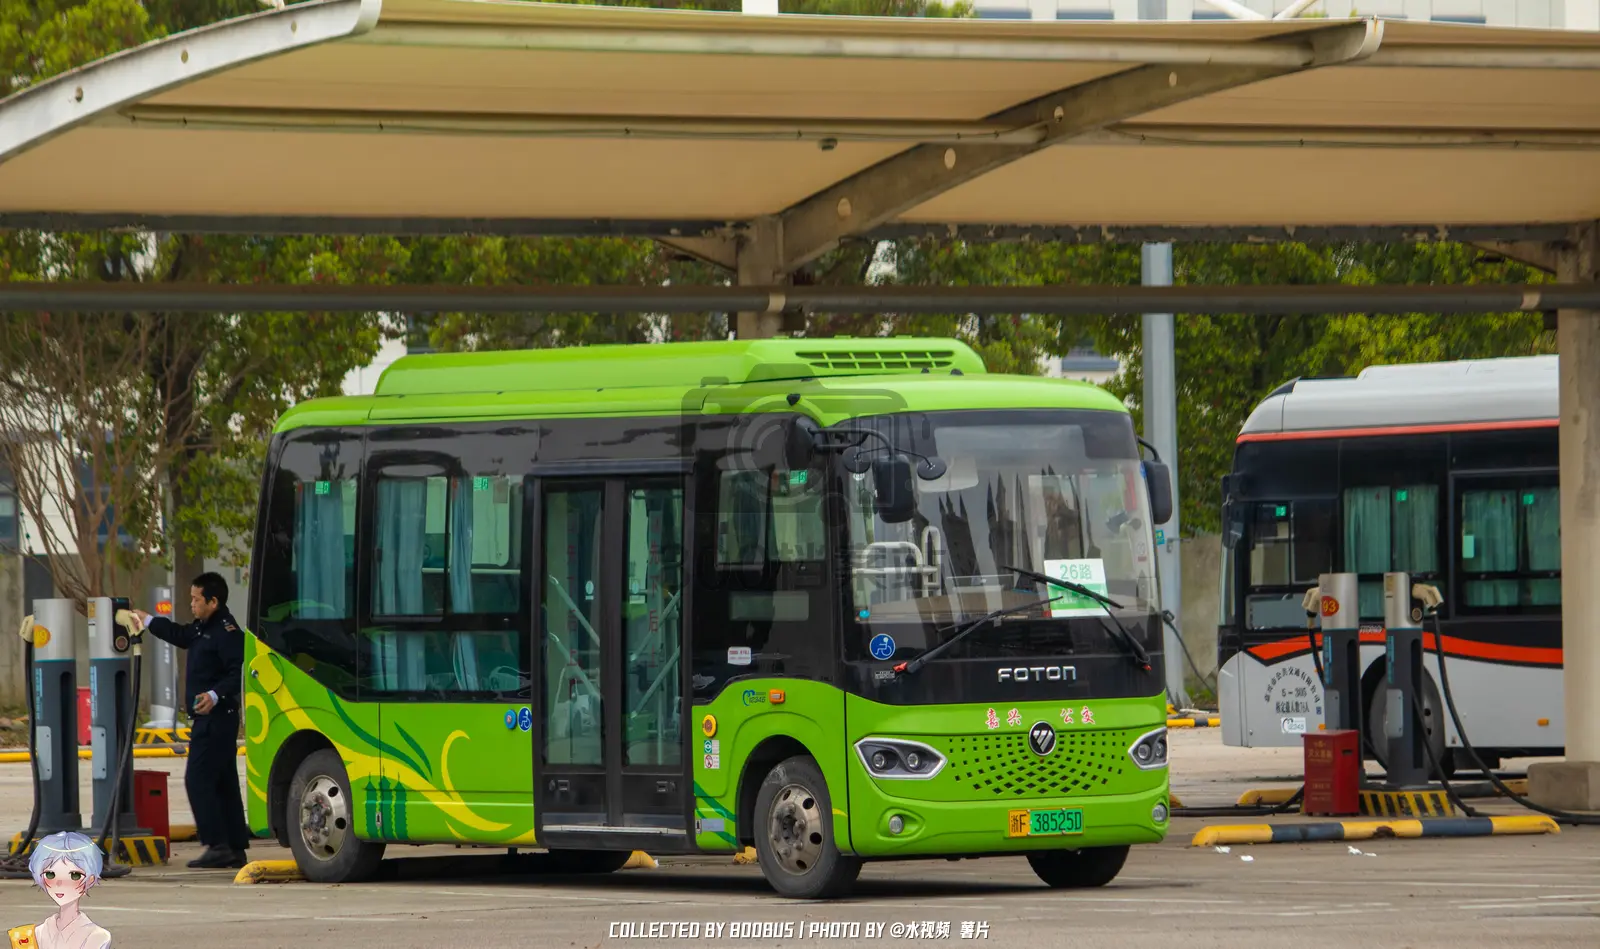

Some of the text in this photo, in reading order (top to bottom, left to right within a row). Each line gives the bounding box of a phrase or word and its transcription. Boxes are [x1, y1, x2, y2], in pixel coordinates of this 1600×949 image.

[1060, 563, 1092, 580] 26路
[998, 666, 1076, 682] FOTON
[985, 706, 1096, 729] 嘉兴 公交
